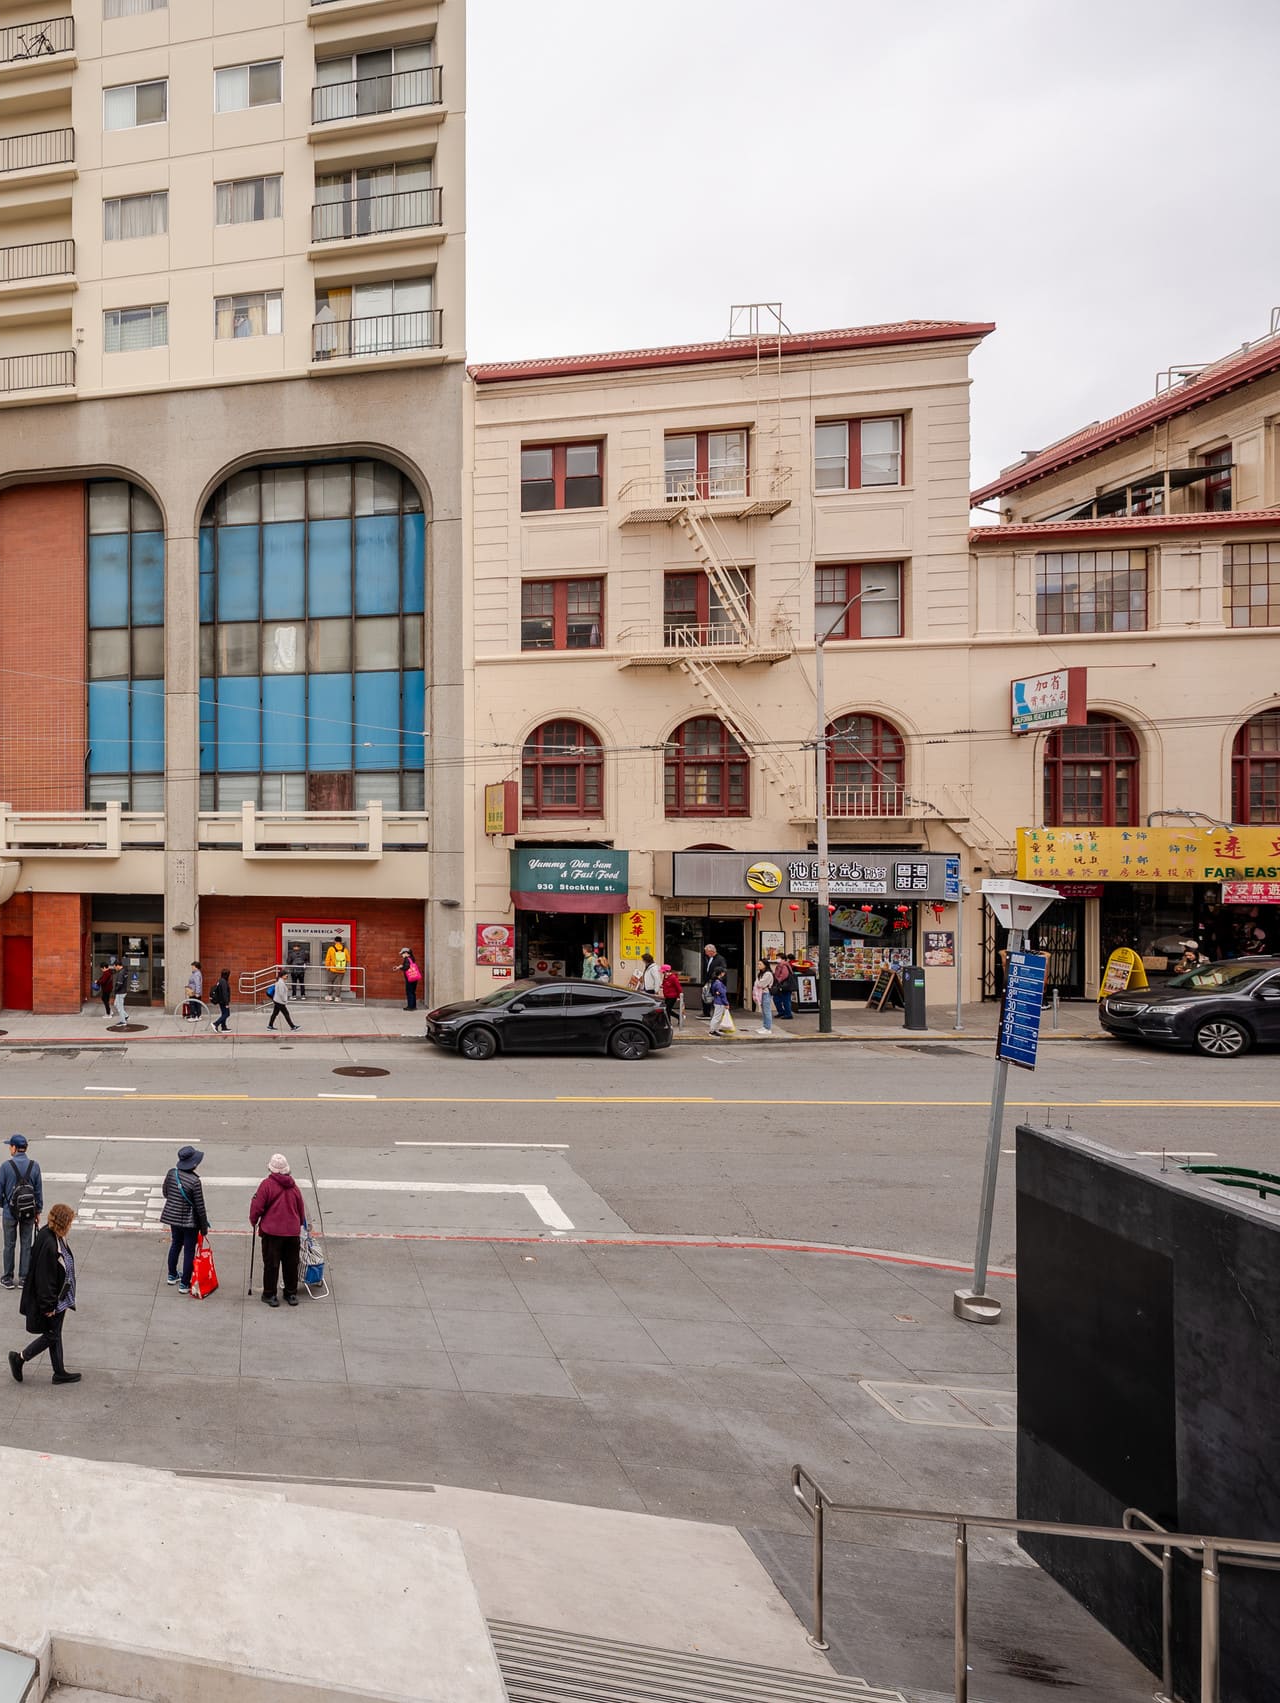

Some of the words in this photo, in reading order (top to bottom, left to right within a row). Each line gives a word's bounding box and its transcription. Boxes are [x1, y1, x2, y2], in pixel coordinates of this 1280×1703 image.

[528, 859, 566, 869] Yummy
[569, 859, 590, 869] Dim
[592, 859, 612, 869] Sum
[561, 870, 568, 878] &
[570, 869, 594, 879] Fast
[595, 869, 620, 880] Food
[1204, 867, 1235, 878] FAR
[897, 877, 927, 888] 甜品
[1013, 966, 1018, 975] 8
[1007, 1000, 1016, 1011] 30
[1006, 1012, 1015, 1023] 45
[1005, 1023, 1013, 1034] 91
